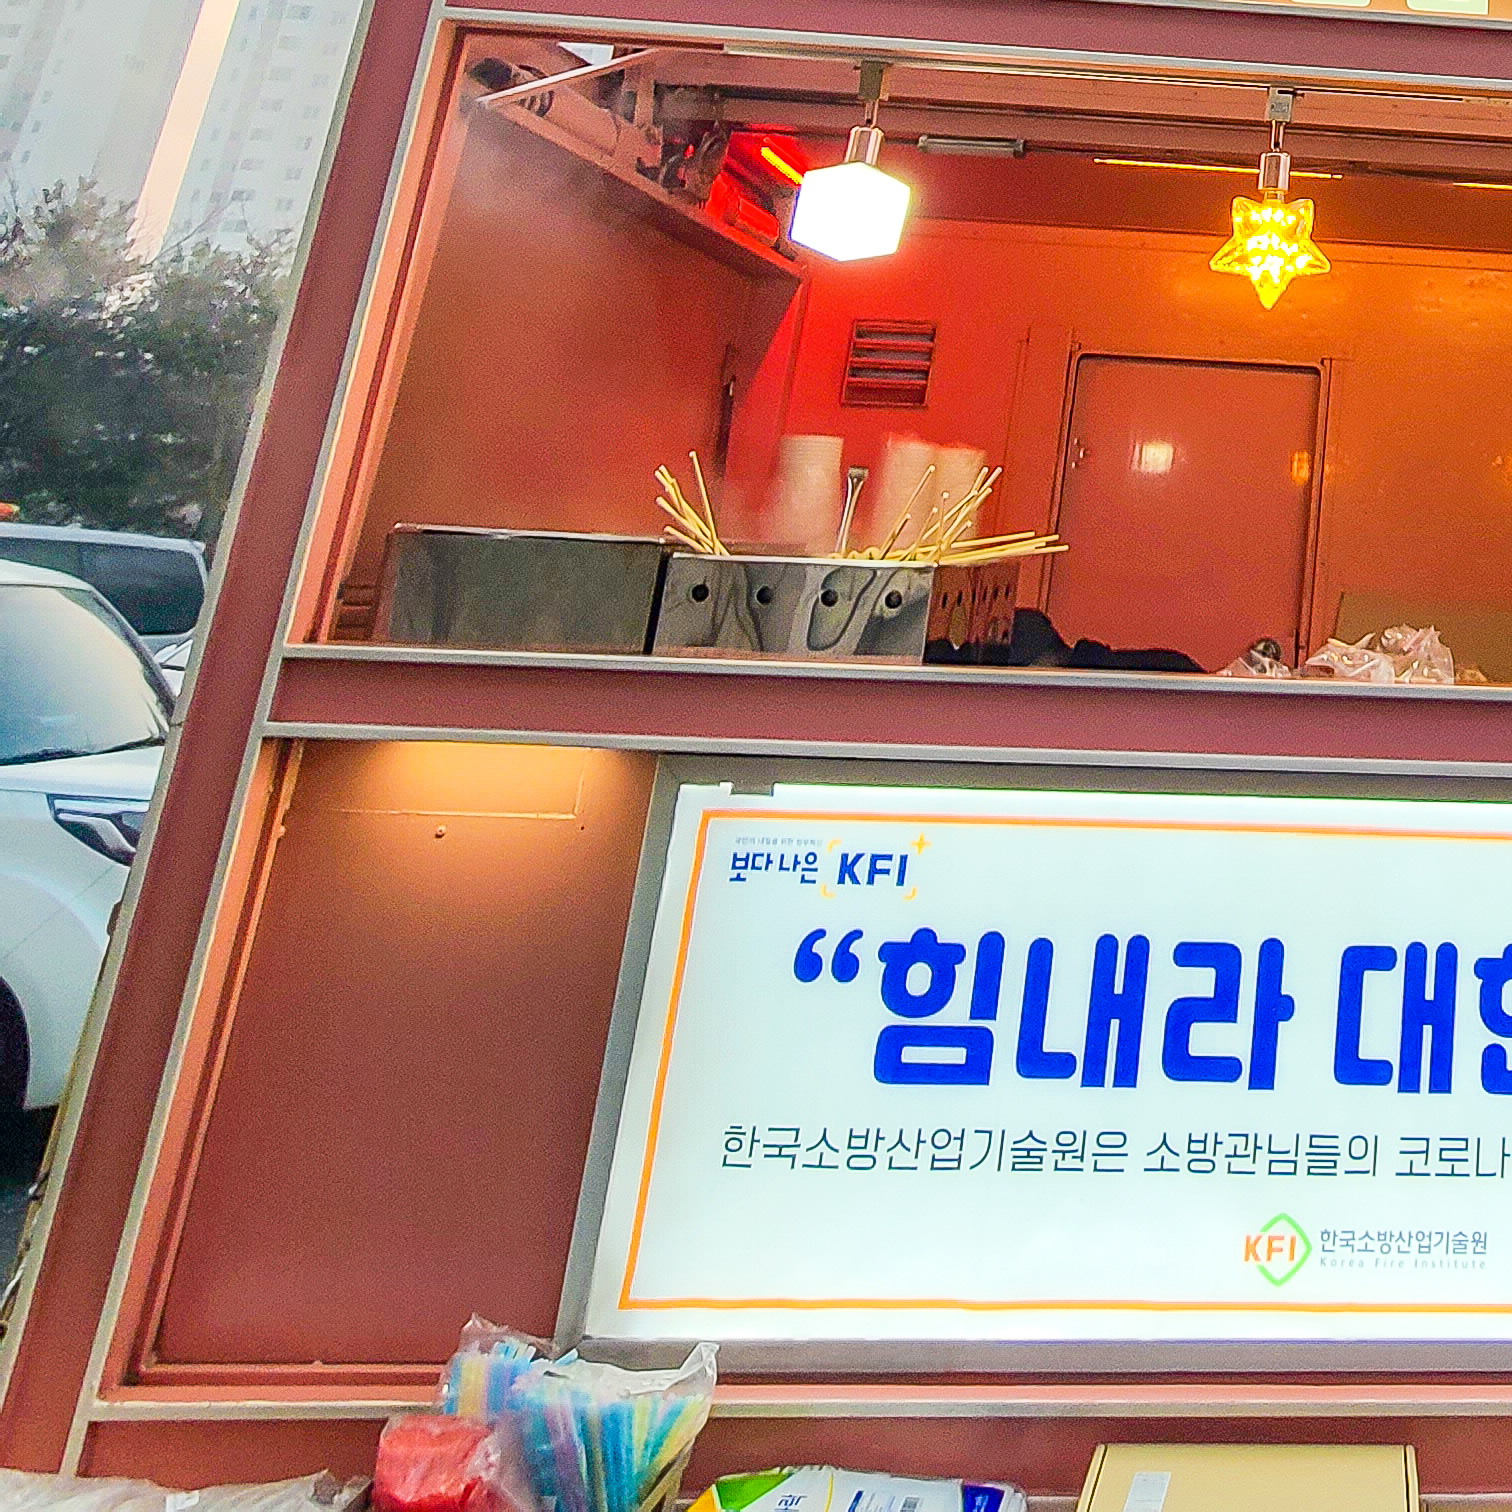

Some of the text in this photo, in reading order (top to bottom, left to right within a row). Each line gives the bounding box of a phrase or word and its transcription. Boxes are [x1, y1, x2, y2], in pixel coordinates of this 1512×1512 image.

[730, 852, 908, 886] 보다 나은 KFI
[794, 928, 1294, 1090] “힘내라
[722, 1126, 1128, 1172] 한국소방산업기술원은
[1144, 1132, 1378, 1176] 소방관님들의
[1243, 1233, 1297, 1262] KFI
[1321, 1229, 1487, 1254] 한국소방산업기술원
[1320, 1257, 1487, 1271] Korea Fire Institute
